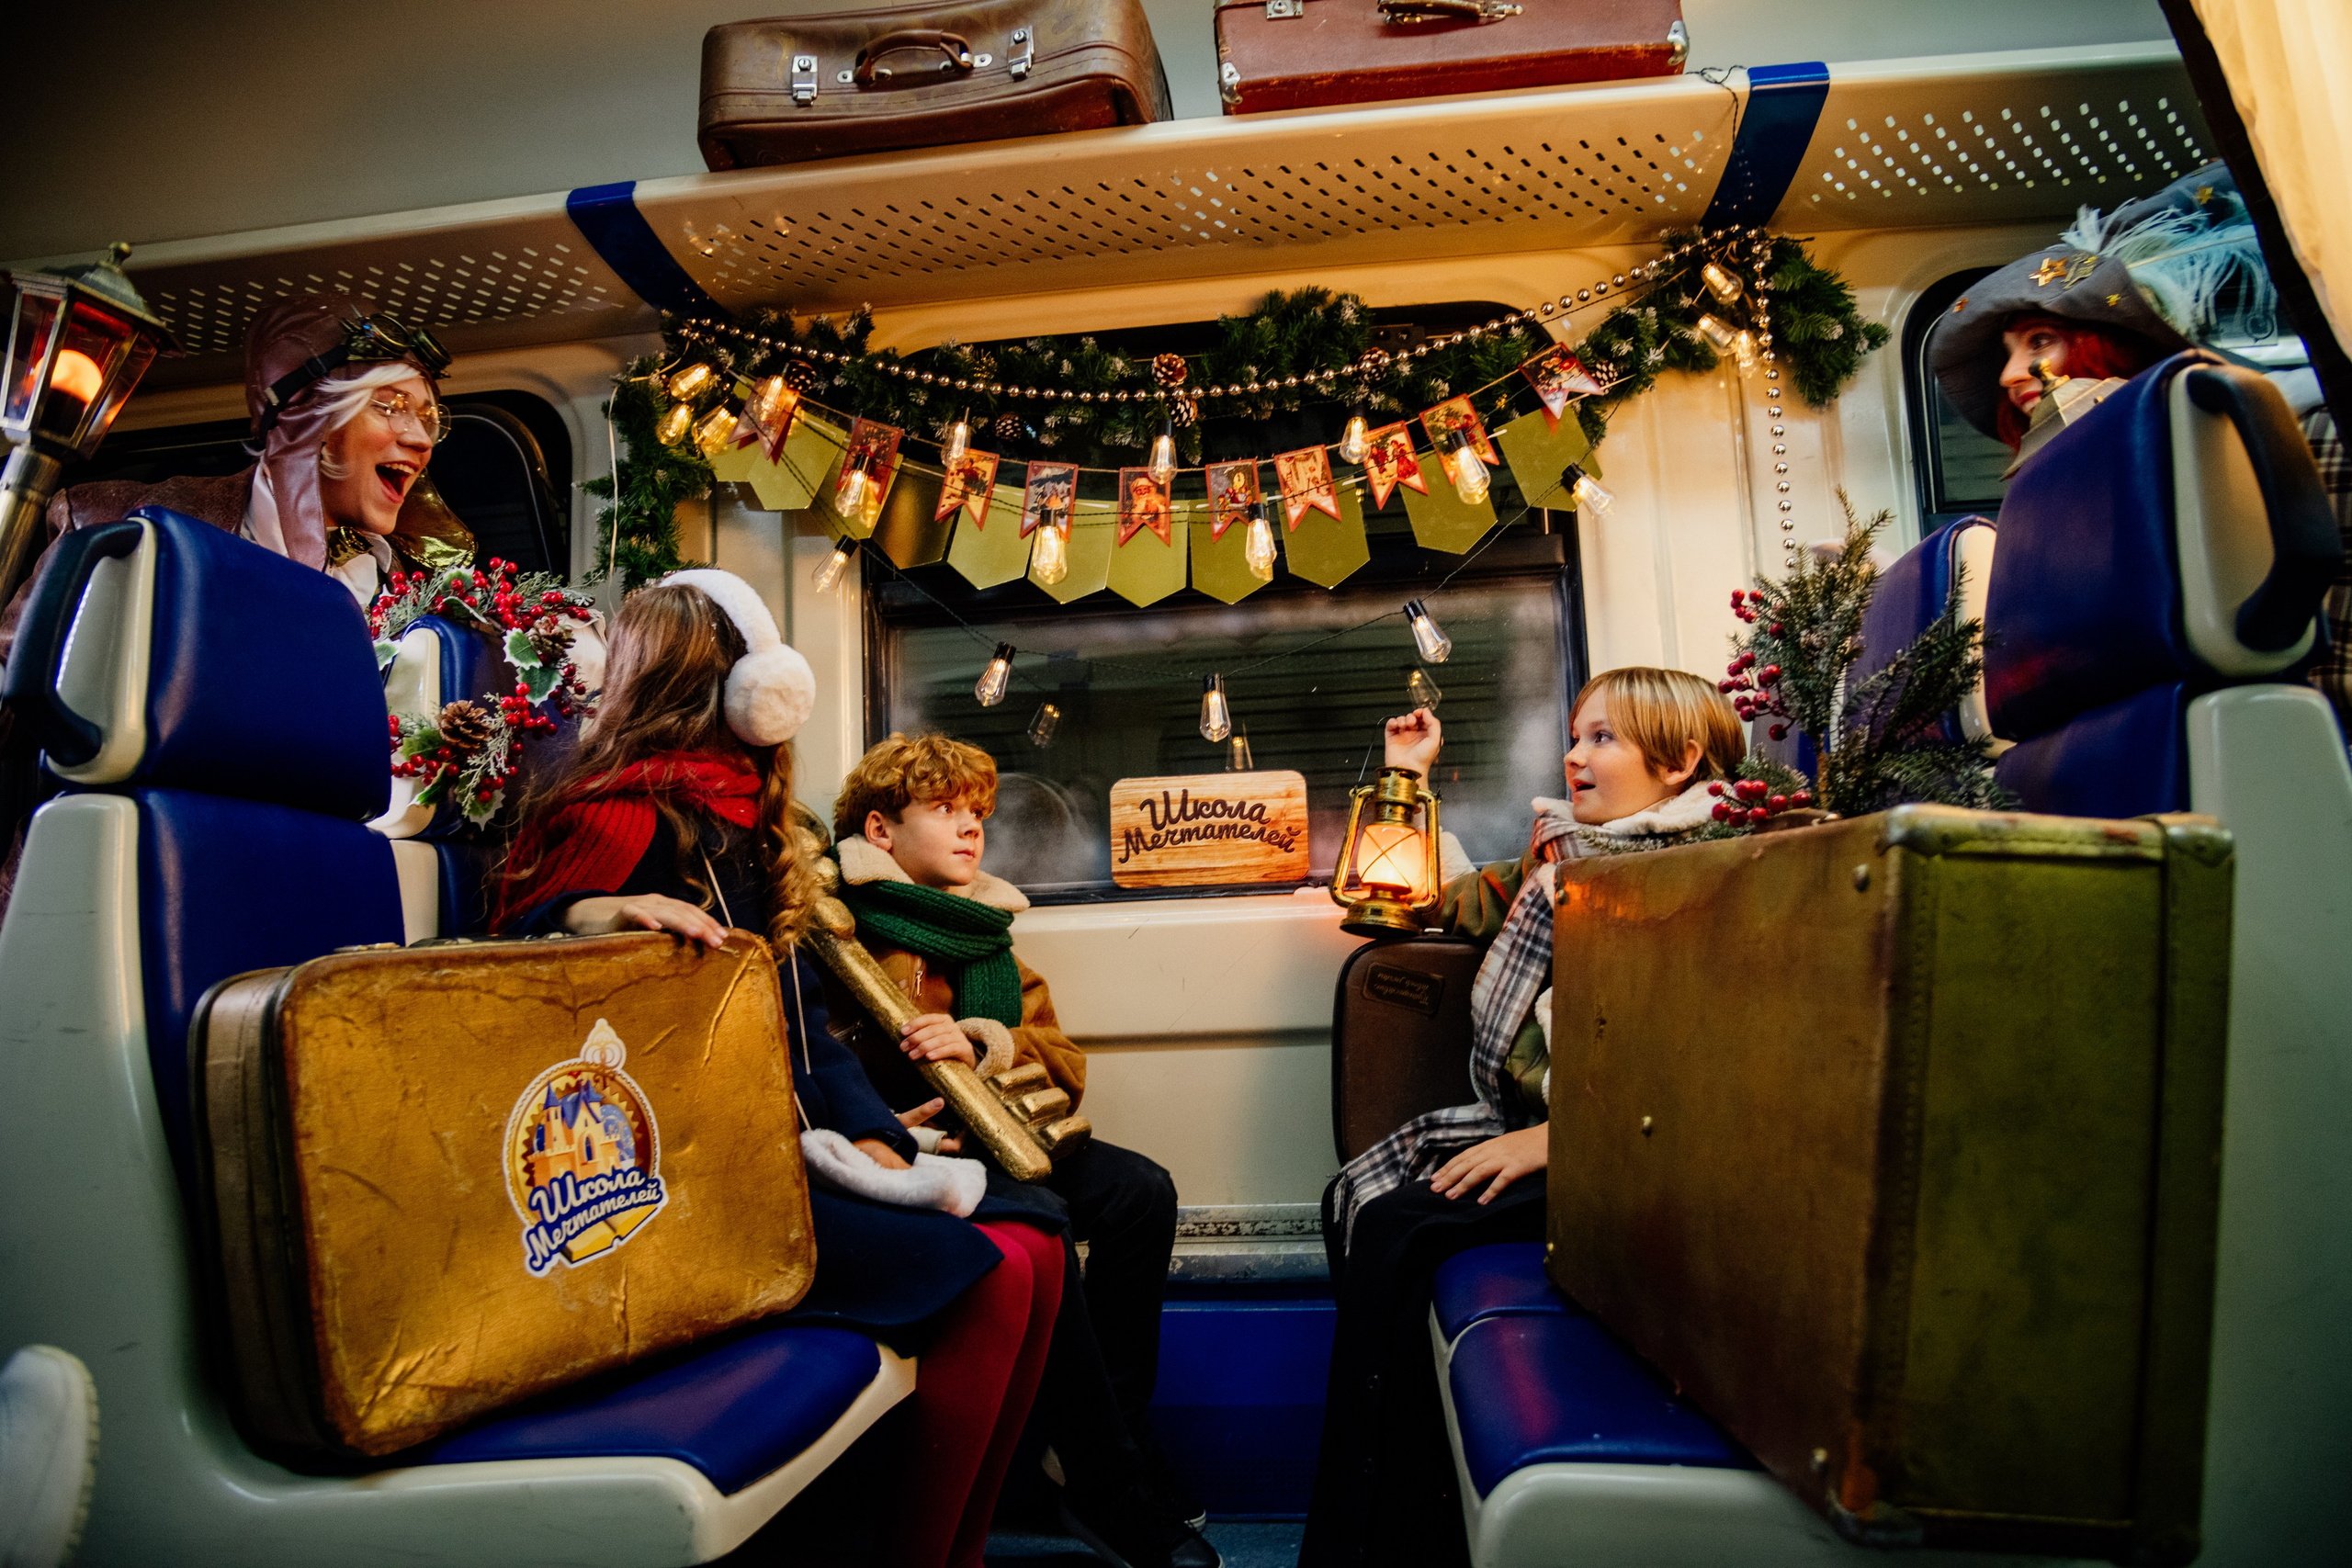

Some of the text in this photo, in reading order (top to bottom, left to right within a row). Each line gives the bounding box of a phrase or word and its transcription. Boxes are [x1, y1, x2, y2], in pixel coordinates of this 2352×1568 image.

[1139, 788, 1271, 830] Школа
[1118, 823, 1301, 863] Мечтателей
[531, 1170, 645, 1223] Школа
[528, 1183, 661, 1267] Мечтателей
